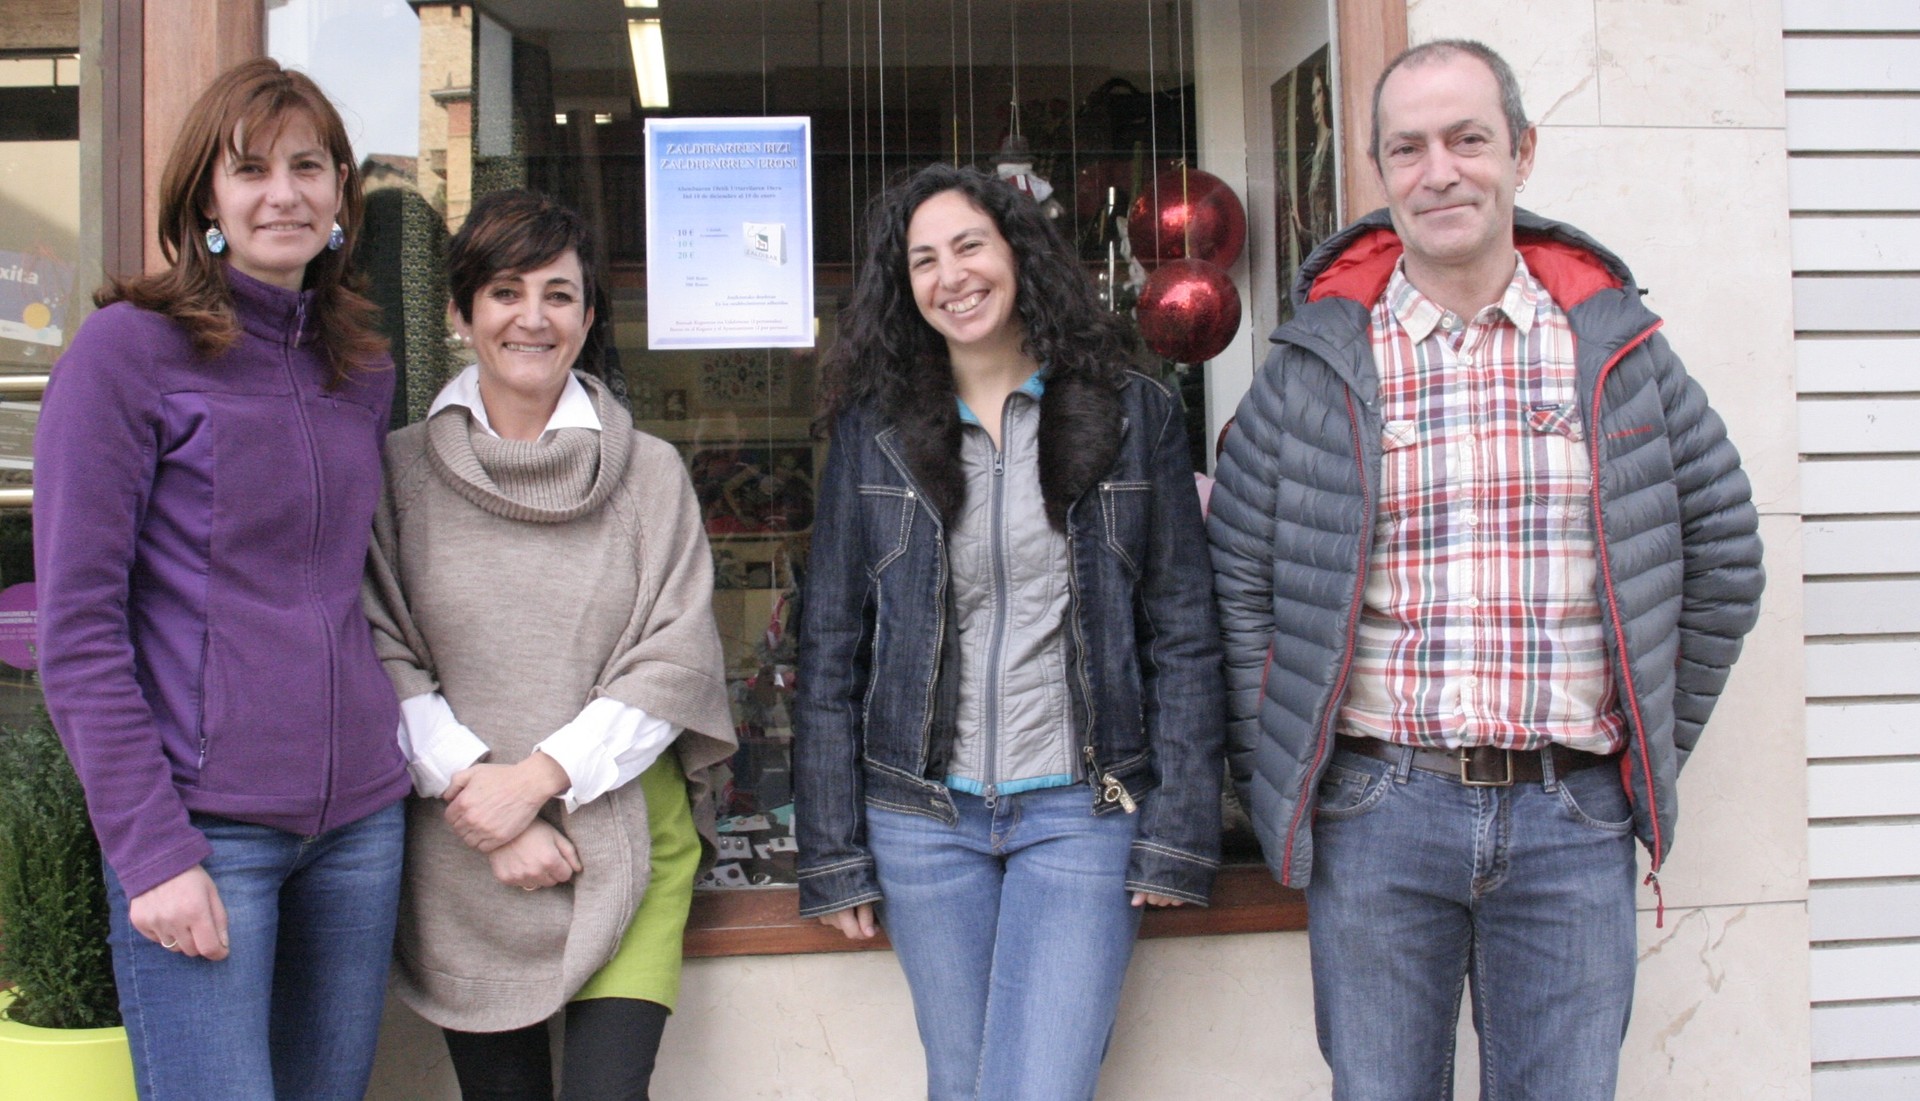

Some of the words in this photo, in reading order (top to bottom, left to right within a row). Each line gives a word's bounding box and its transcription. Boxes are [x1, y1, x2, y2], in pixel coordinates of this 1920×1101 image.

[666, 142, 760, 155] ZALDIBARREN
[763, 142, 792, 155] BIZI
[660, 158, 755, 170] ZALDIBARREN
[678, 229, 688, 237] 10
[678, 252, 688, 260] 20
